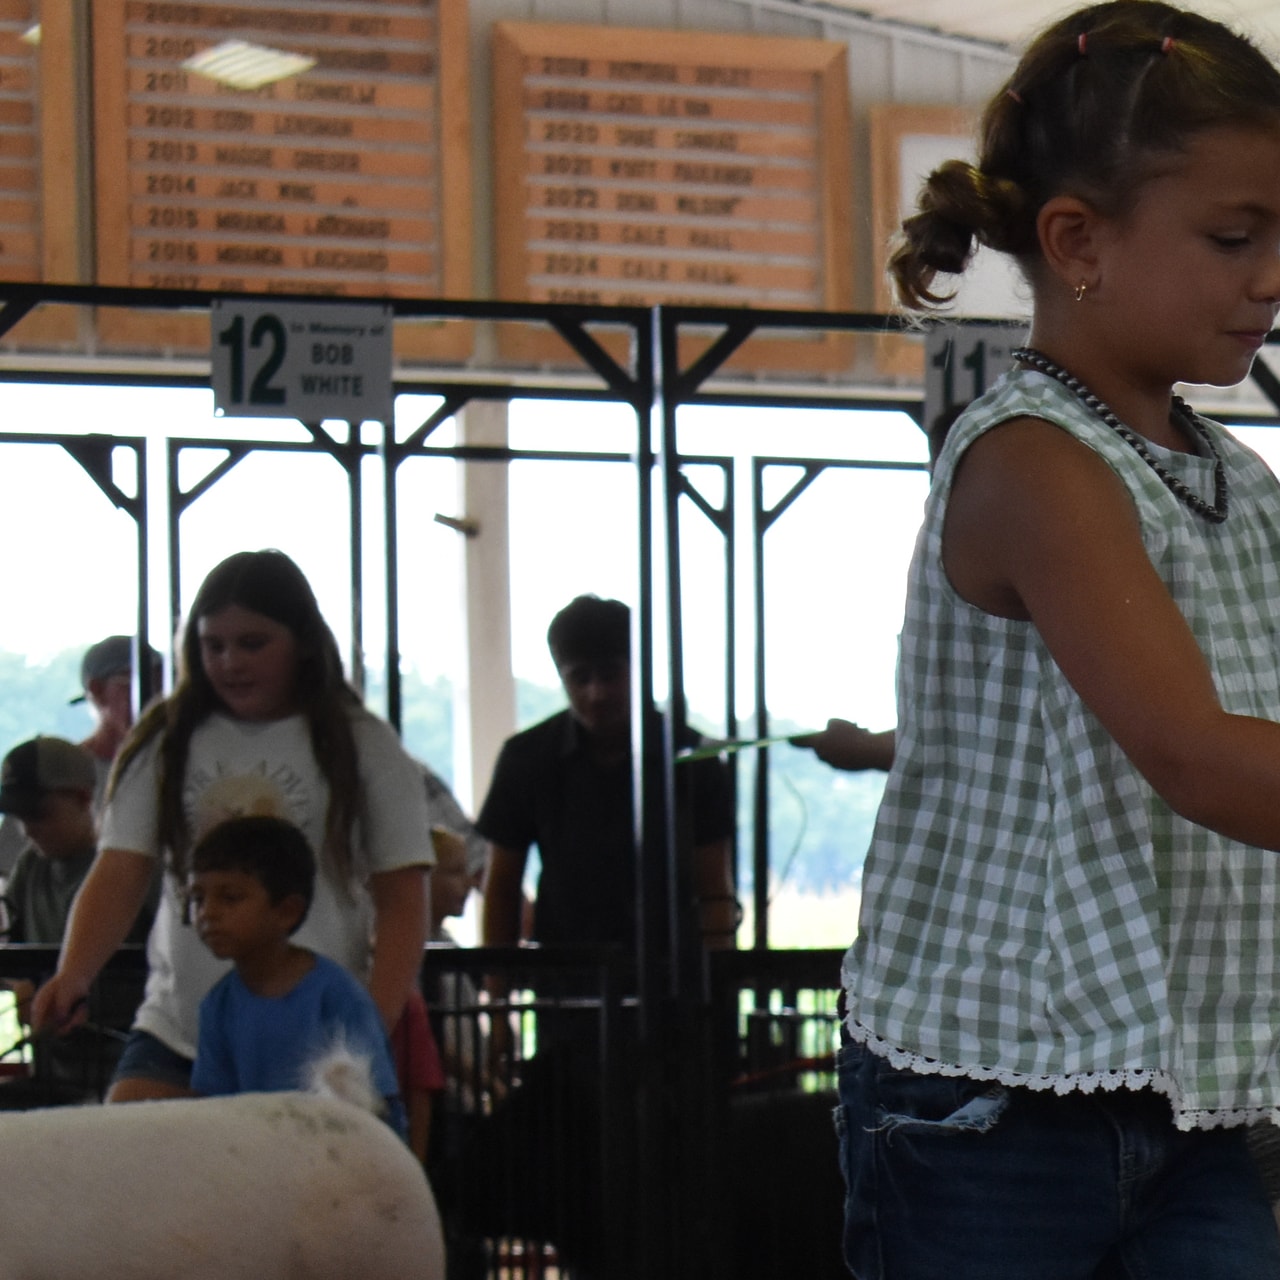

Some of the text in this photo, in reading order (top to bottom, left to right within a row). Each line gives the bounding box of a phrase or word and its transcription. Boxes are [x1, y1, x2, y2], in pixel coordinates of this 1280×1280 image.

[146, 73, 189, 92] 2011
[146, 107, 195, 129] 2012
[146, 175, 196, 194] 2014
[309, 323, 366, 337] Memory
[219, 313, 287, 406] 12
[312, 343, 354, 365] BOB
[301, 374, 364, 397] WHITE
[932, 339, 985, 410] 11
